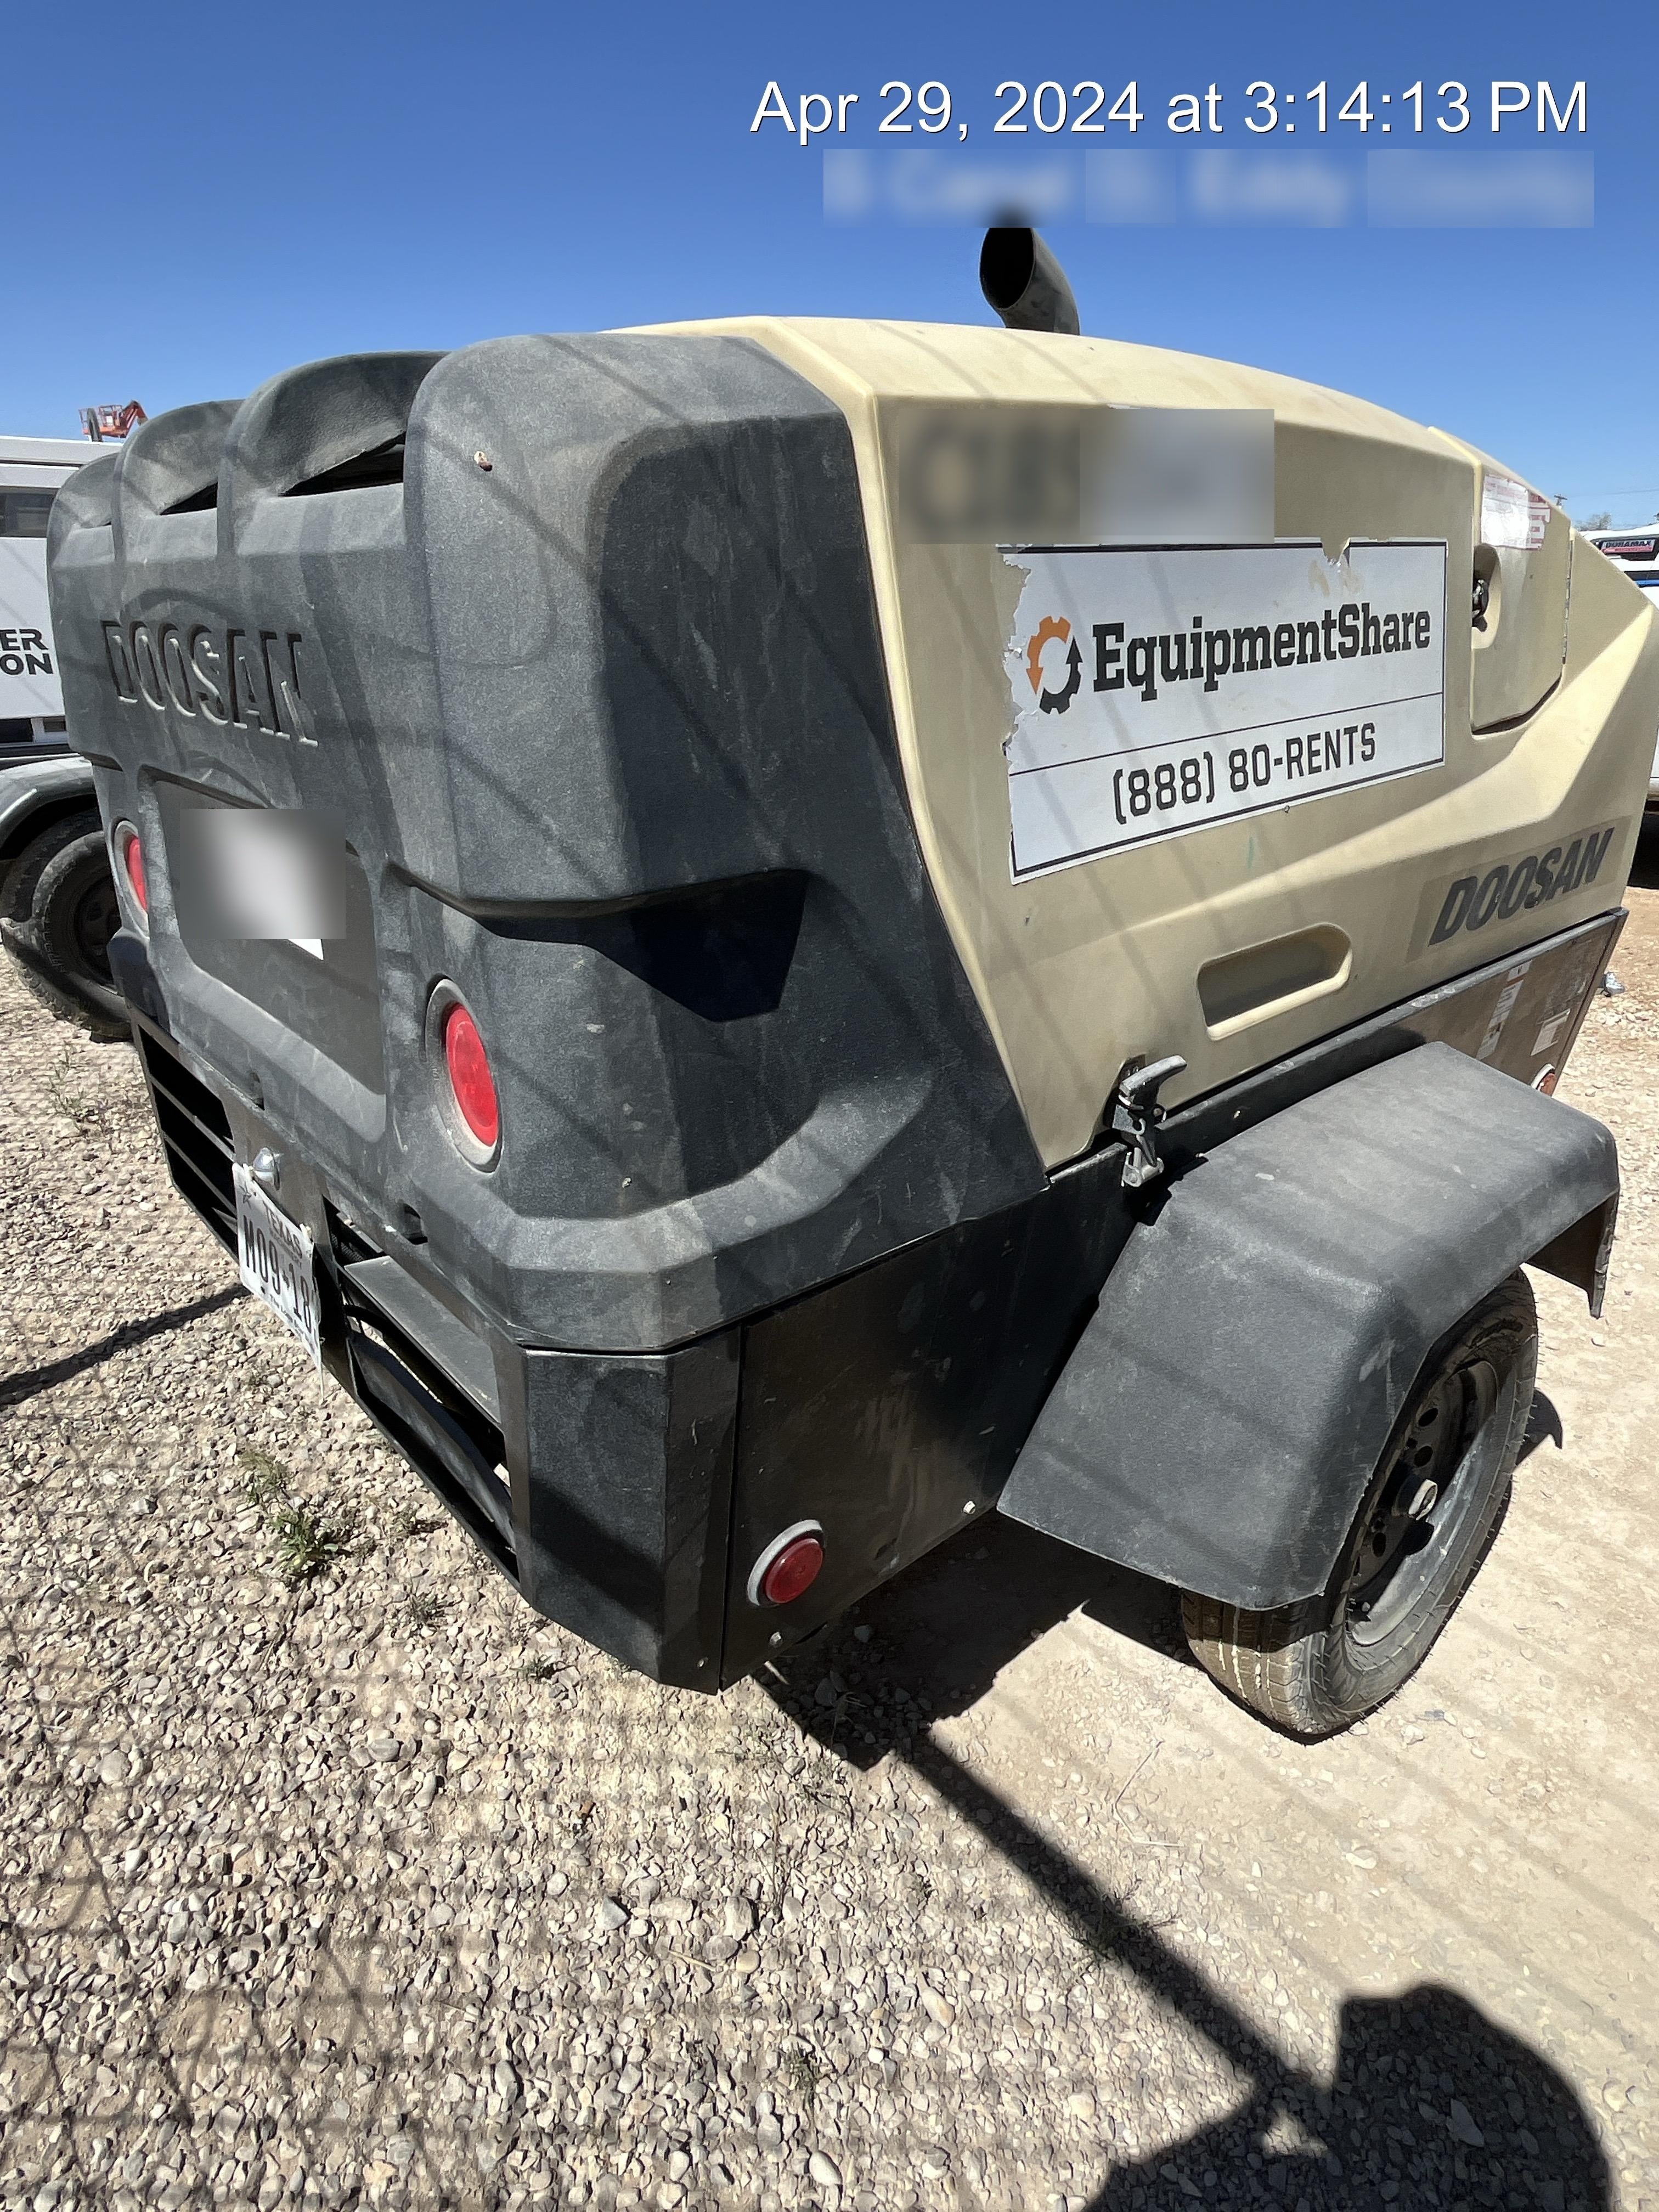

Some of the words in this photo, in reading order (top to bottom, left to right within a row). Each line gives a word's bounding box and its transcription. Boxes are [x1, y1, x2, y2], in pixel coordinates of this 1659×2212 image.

[101, 620, 318, 747] DOOSAN
[1093, 603, 1430, 702] EquipmentShare
[1114, 751, 1215, 825] (888)
[1229, 723, 1376, 792] 80-RENTS
[1428, 827, 1615, 947] DOOSAN
[263, 1200, 302, 1259] TEXAS
